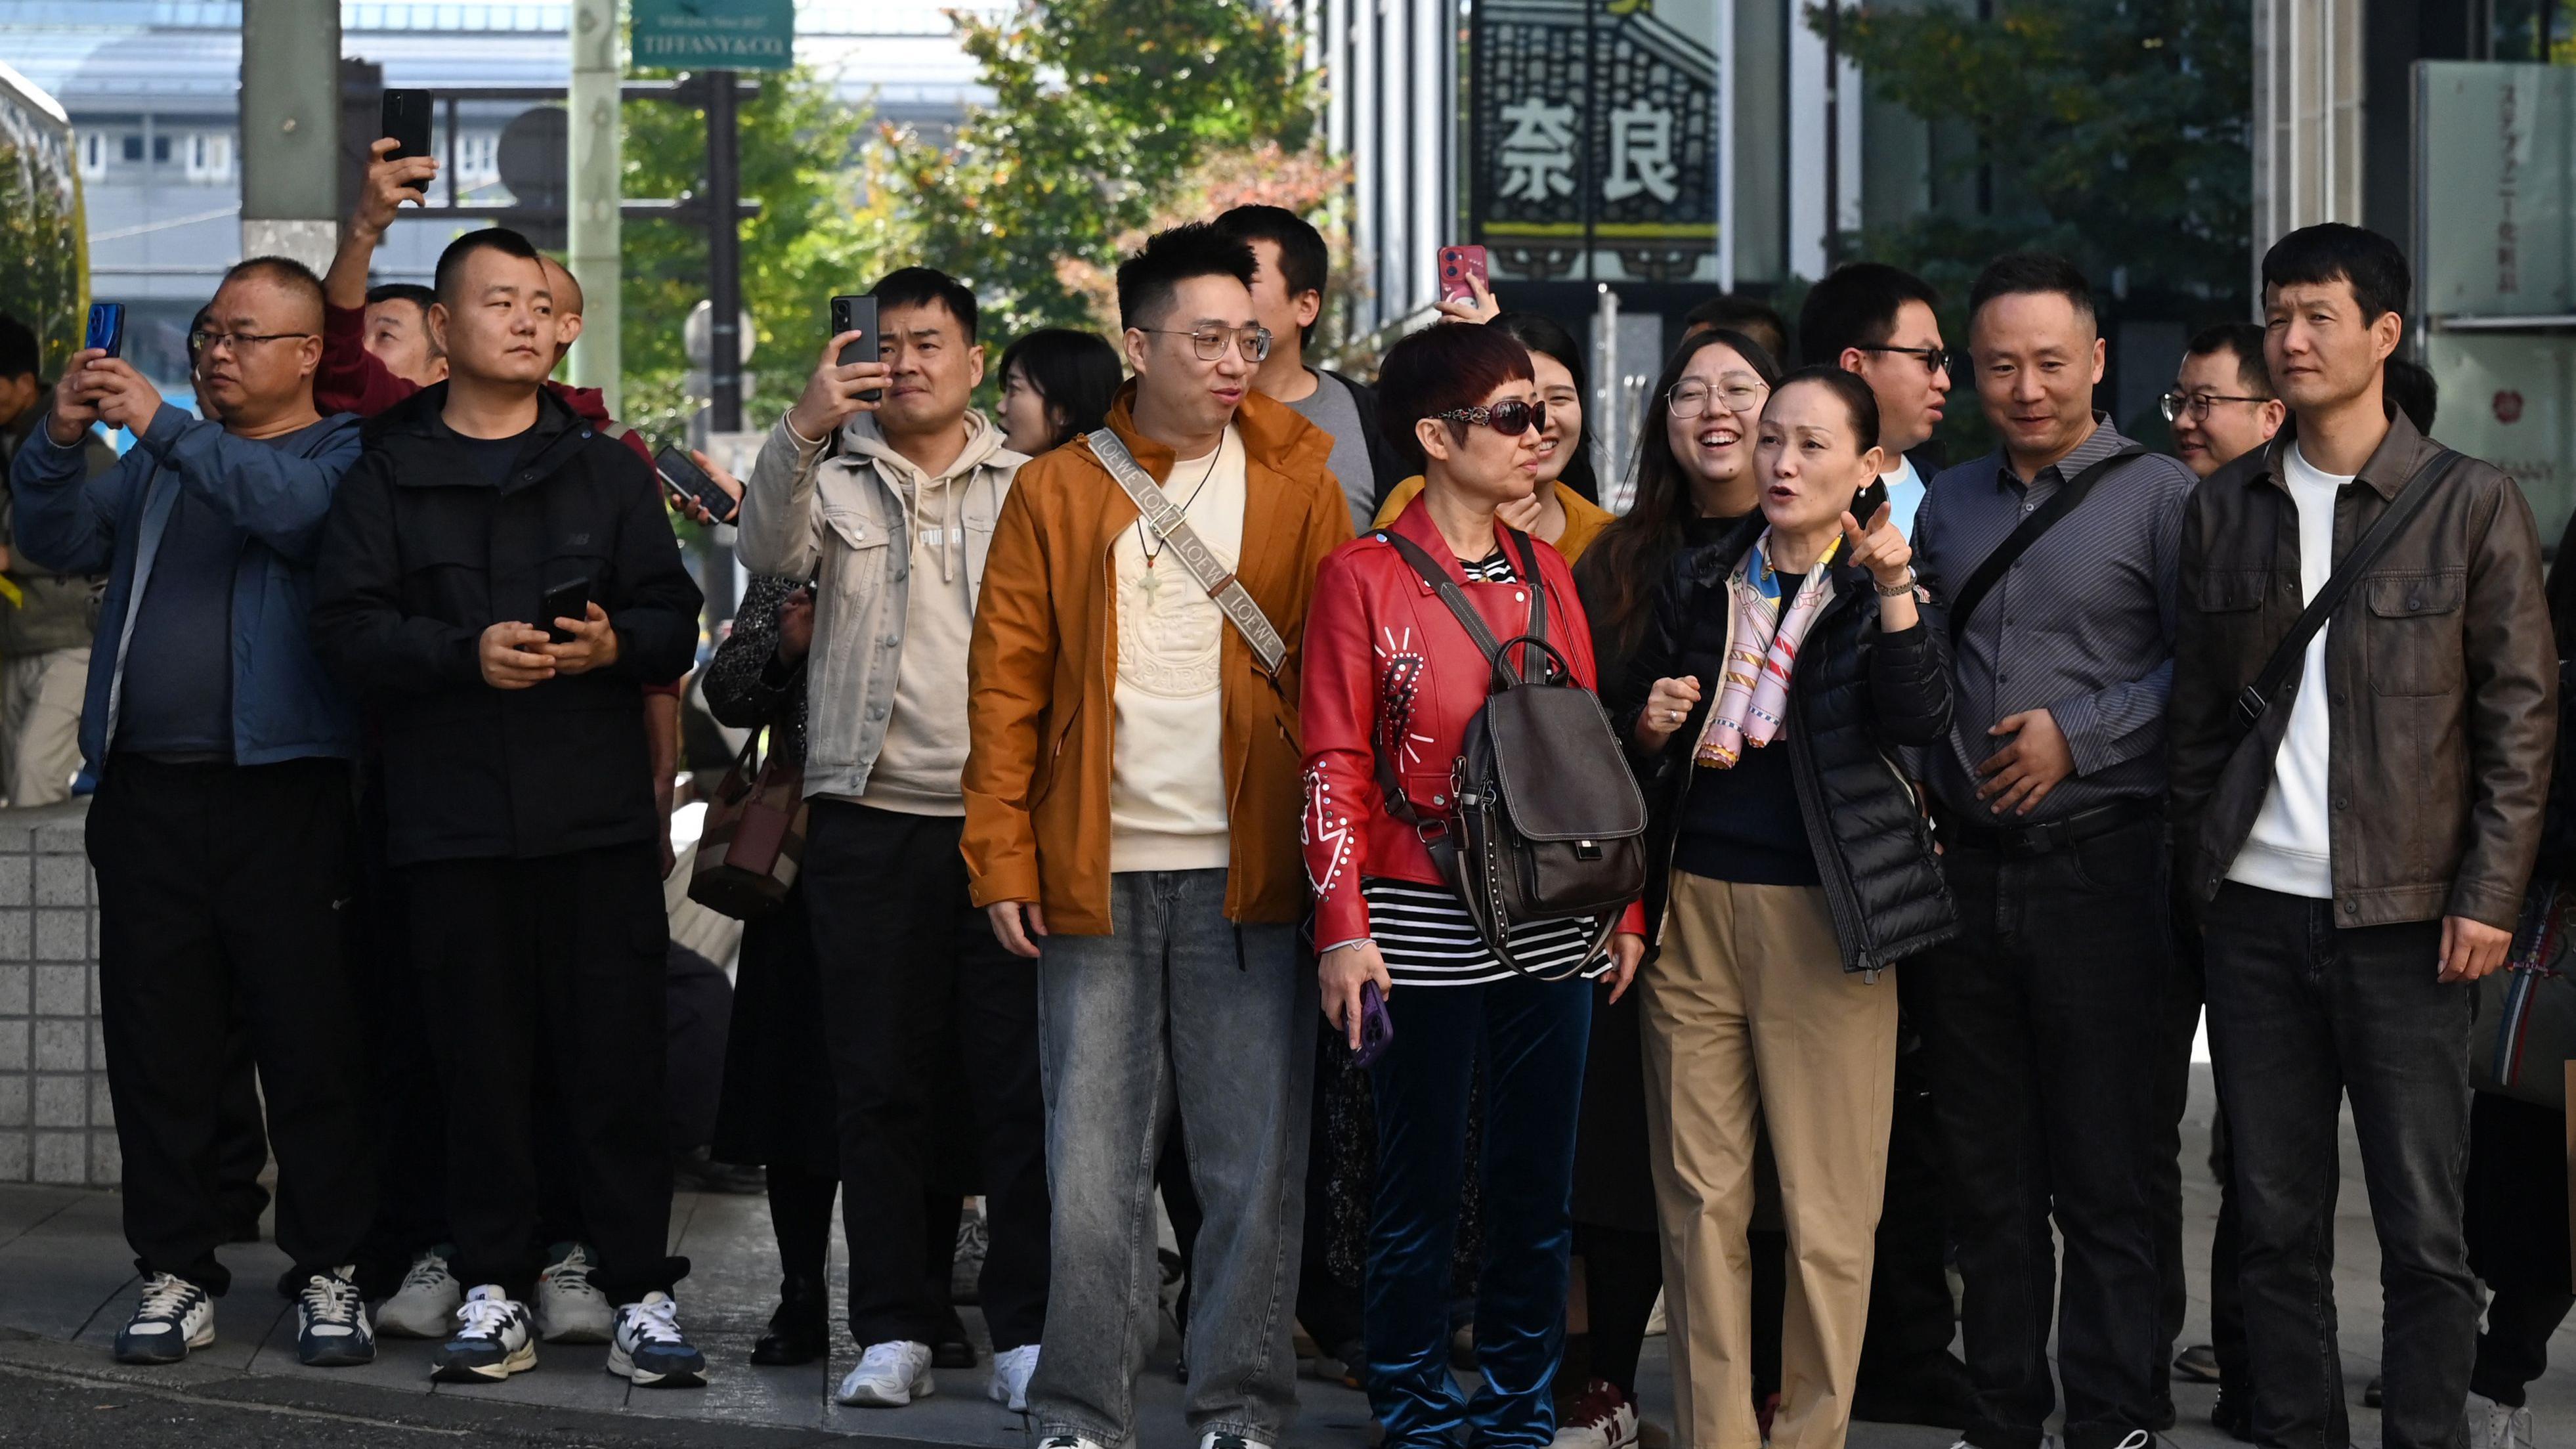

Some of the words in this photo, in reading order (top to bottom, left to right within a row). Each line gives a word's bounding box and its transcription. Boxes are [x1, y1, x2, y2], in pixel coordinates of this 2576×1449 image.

[1500, 97, 1679, 203] 奈良
[1098, 438, 1142, 487] LOEWE
[1137, 485, 1176, 525] LOEW
[1179, 536, 1224, 584] LOEW
[1229, 595, 1277, 653] LOEWE
